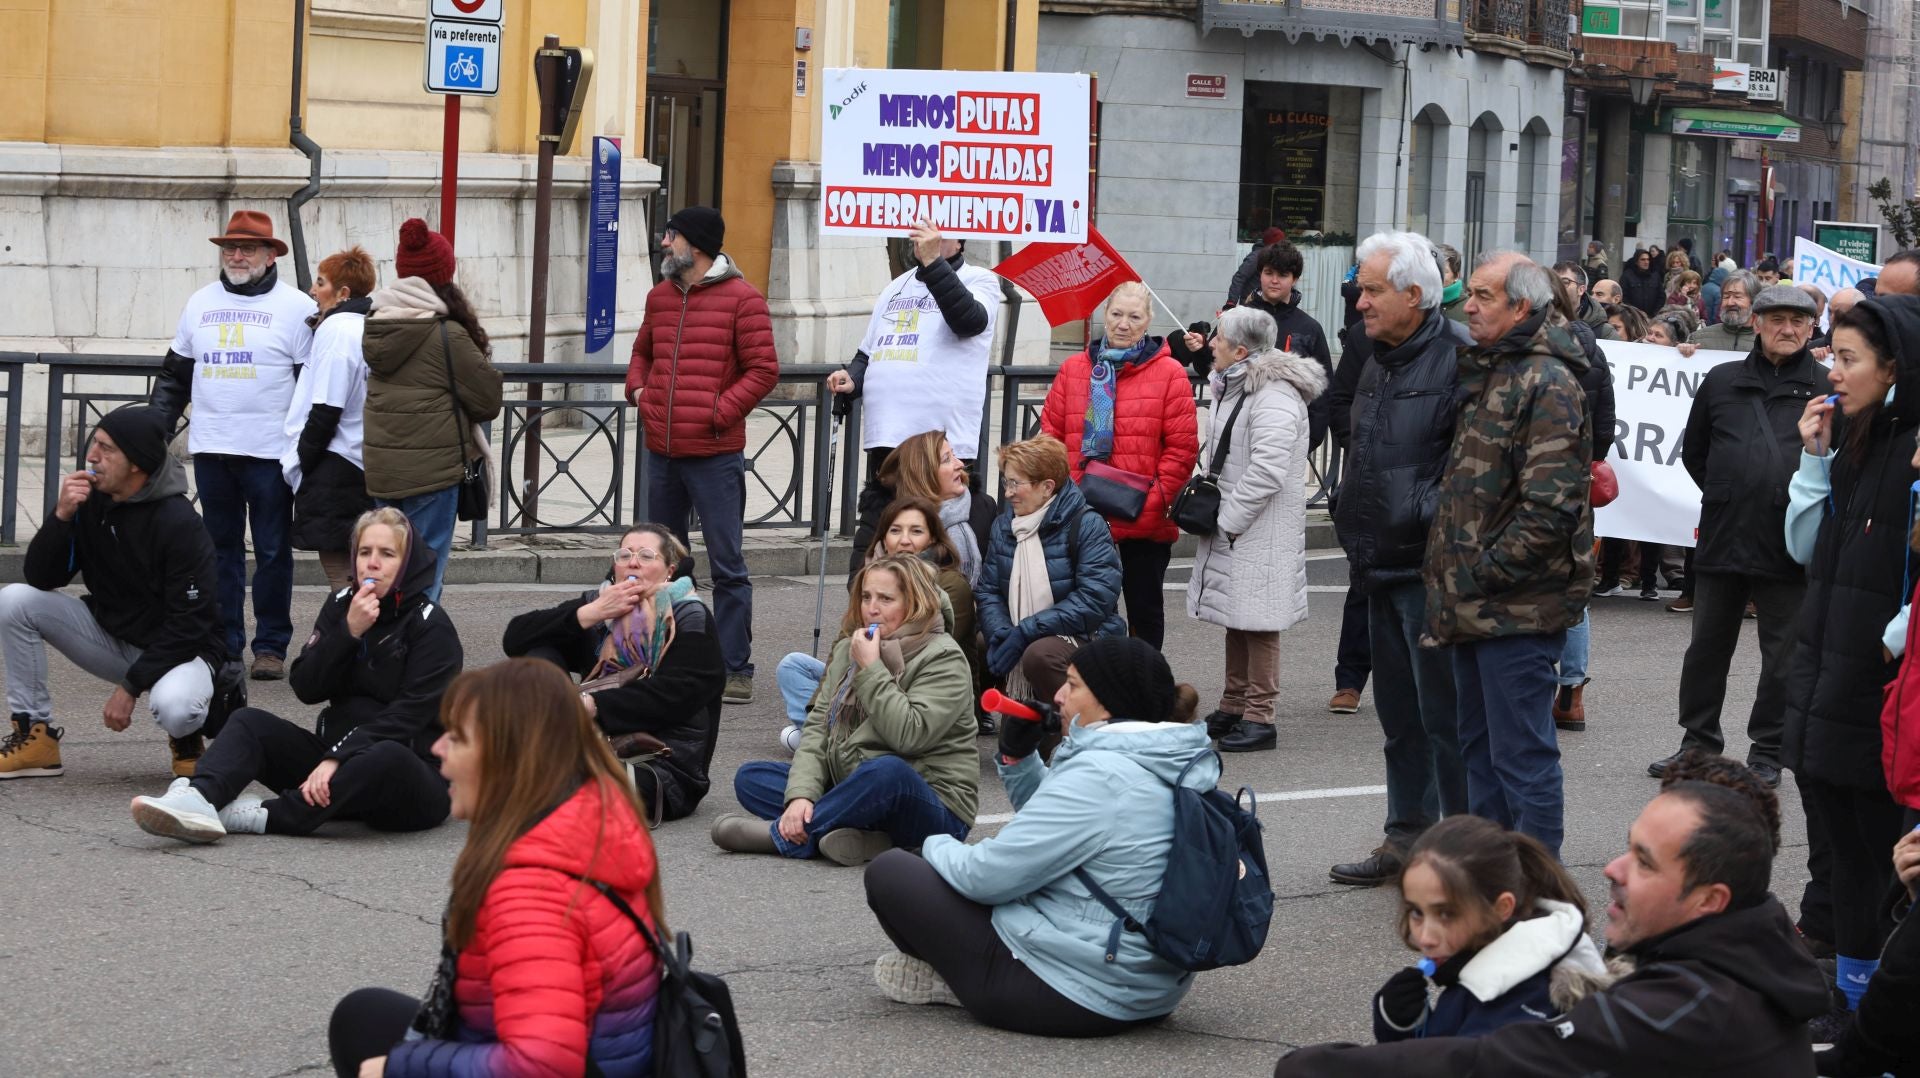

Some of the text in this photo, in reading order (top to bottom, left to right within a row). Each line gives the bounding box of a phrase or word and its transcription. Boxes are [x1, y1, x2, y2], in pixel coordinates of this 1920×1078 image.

[450, 29, 497, 43] preferente
[842, 80, 869, 107] adif
[879, 93, 1036, 132] MENOS PUTAS
[1268, 112, 1282, 125] LA
[862, 142, 1050, 183] MENOS PUTADAS
[827, 190, 1021, 233] SOTERRAMIENTO
[1845, 246, 1870, 255] recicla
[1848, 239, 1870, 249] vidrio
[201, 311, 270, 325] SOTERRAMIENTO
[218, 322, 245, 348] YA
[896, 333, 920, 346] TREN
[212, 352, 222, 364] EL
[226, 351, 253, 364] TREN
